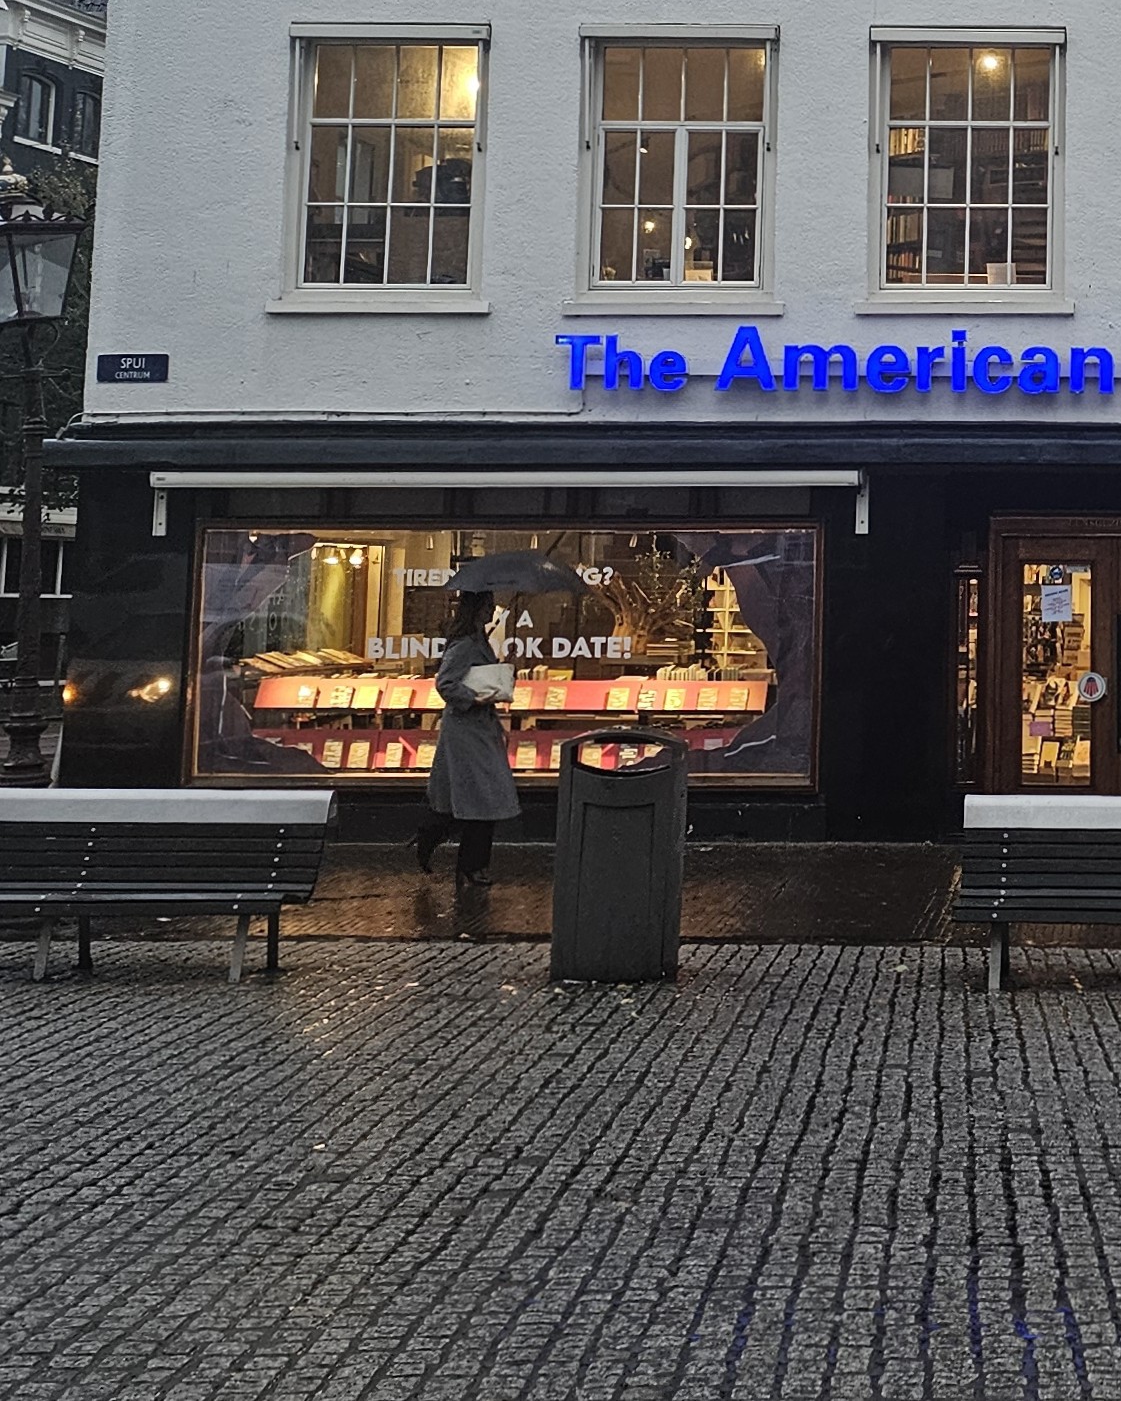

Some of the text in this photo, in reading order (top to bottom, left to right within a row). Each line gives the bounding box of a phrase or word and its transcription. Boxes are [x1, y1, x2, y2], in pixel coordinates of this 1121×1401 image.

[120, 357, 146, 369] SPUI
[555, 333, 690, 393] The
[713, 324, 1117, 396] American
[115, 371, 151, 380] CENTRUM
[393, 568, 457, 587] TIRED
[516, 609, 534, 628] A
[368, 636, 632, 660] BLIND OK DATE!
